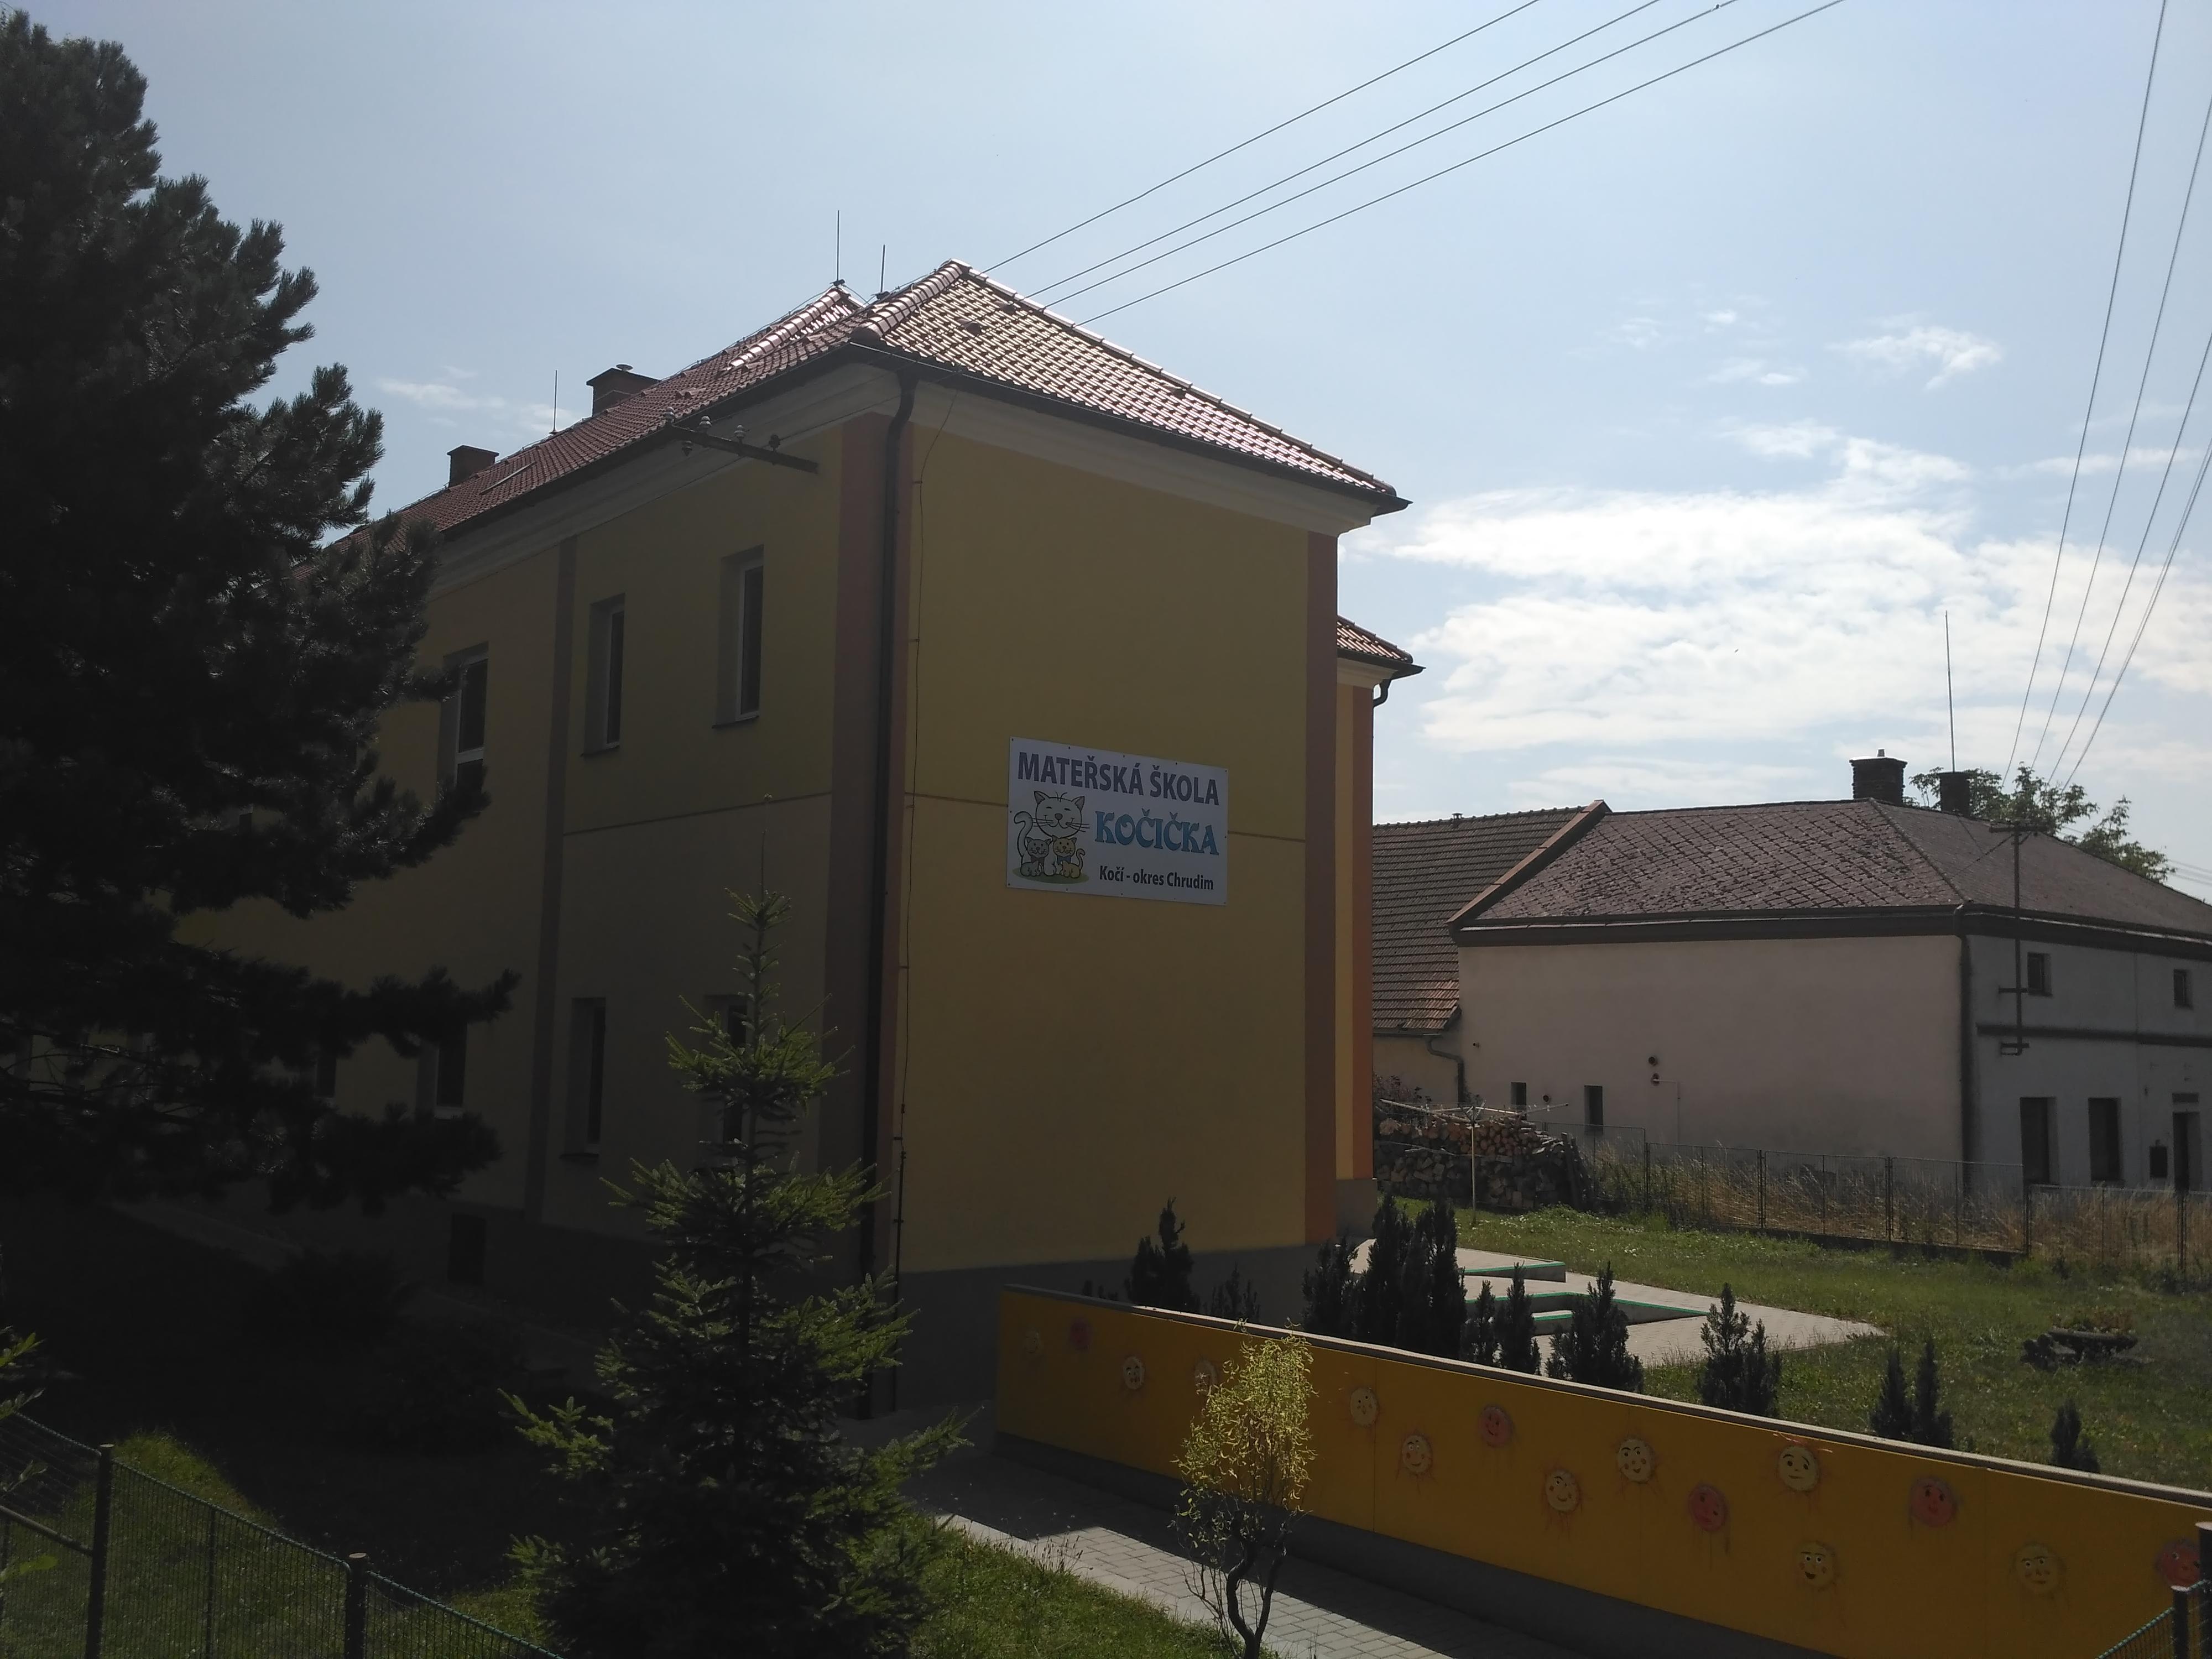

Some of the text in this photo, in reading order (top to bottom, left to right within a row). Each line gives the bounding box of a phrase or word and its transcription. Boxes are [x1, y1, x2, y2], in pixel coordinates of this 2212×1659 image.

[1018, 752, 1219, 806] MATEŘSKÁ ŠKOLA
[1095, 808, 1219, 855] KOČIČKA
[1099, 865, 1125, 882] Kočí
[1133, 869, 1164, 886] okres
[1167, 872, 1214, 890] Chrudim
